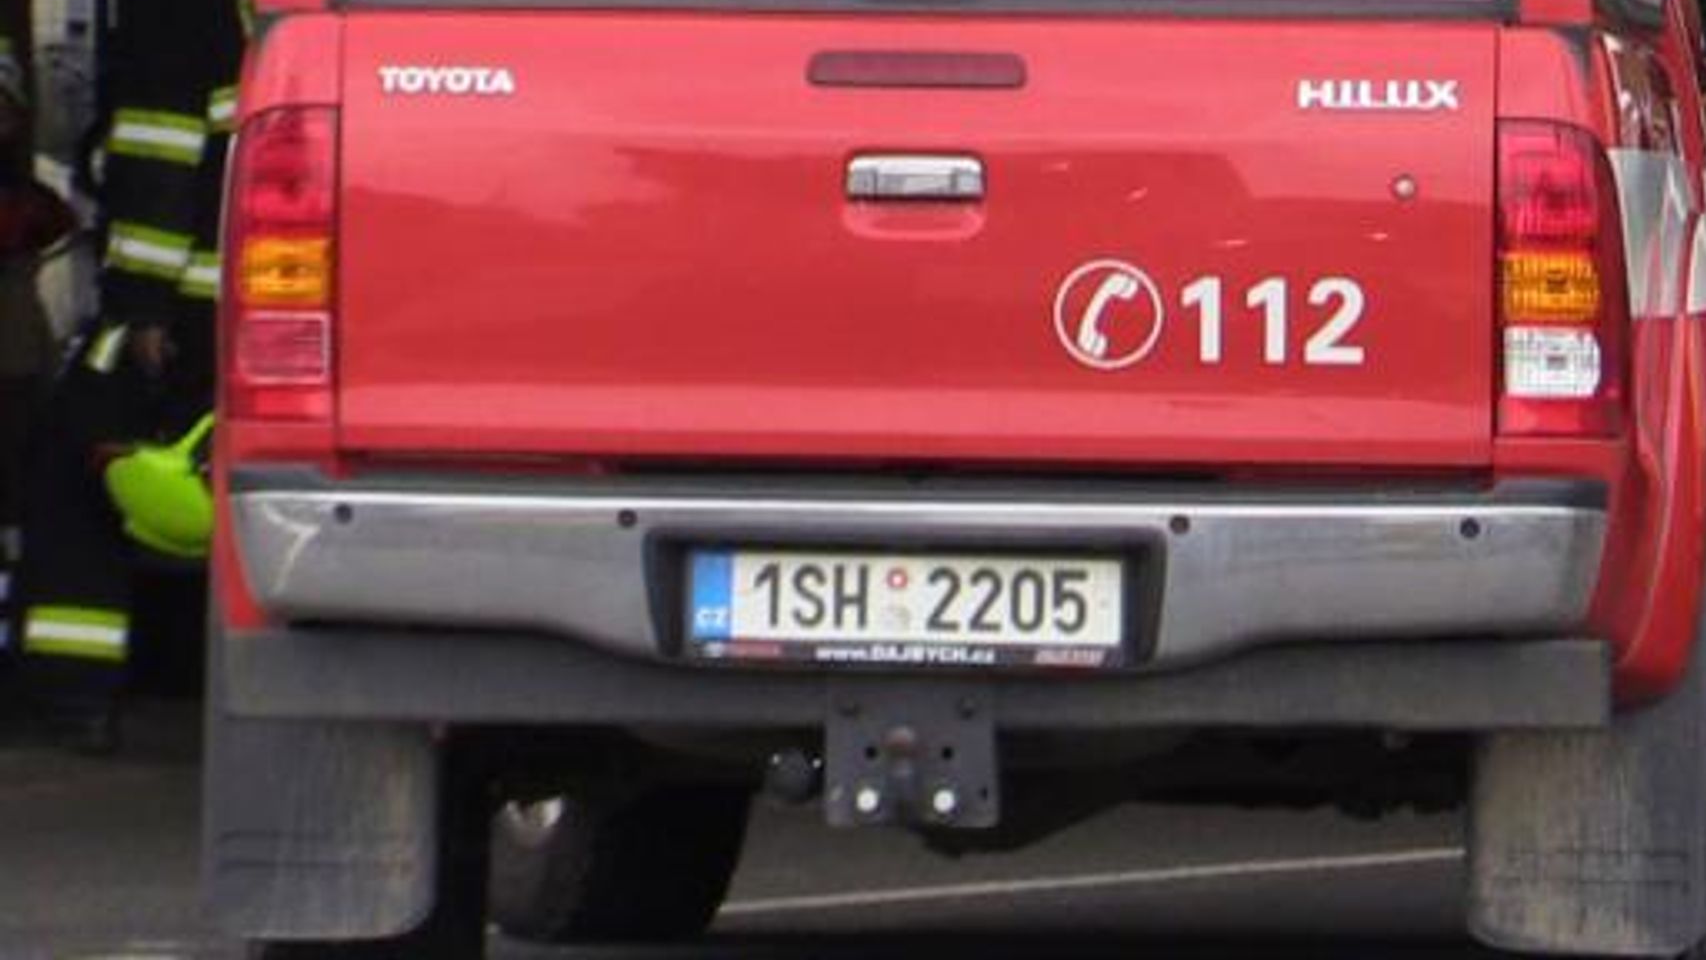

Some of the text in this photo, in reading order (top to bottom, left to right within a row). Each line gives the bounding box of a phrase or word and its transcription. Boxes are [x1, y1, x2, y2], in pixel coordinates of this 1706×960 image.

[378, 67, 514, 93] TOYOTA
[1298, 80, 1458, 109] HILUX
[1182, 277, 1364, 364] 112
[753, 563, 1088, 633] 1SH 2205
[697, 607, 728, 628] CZ
